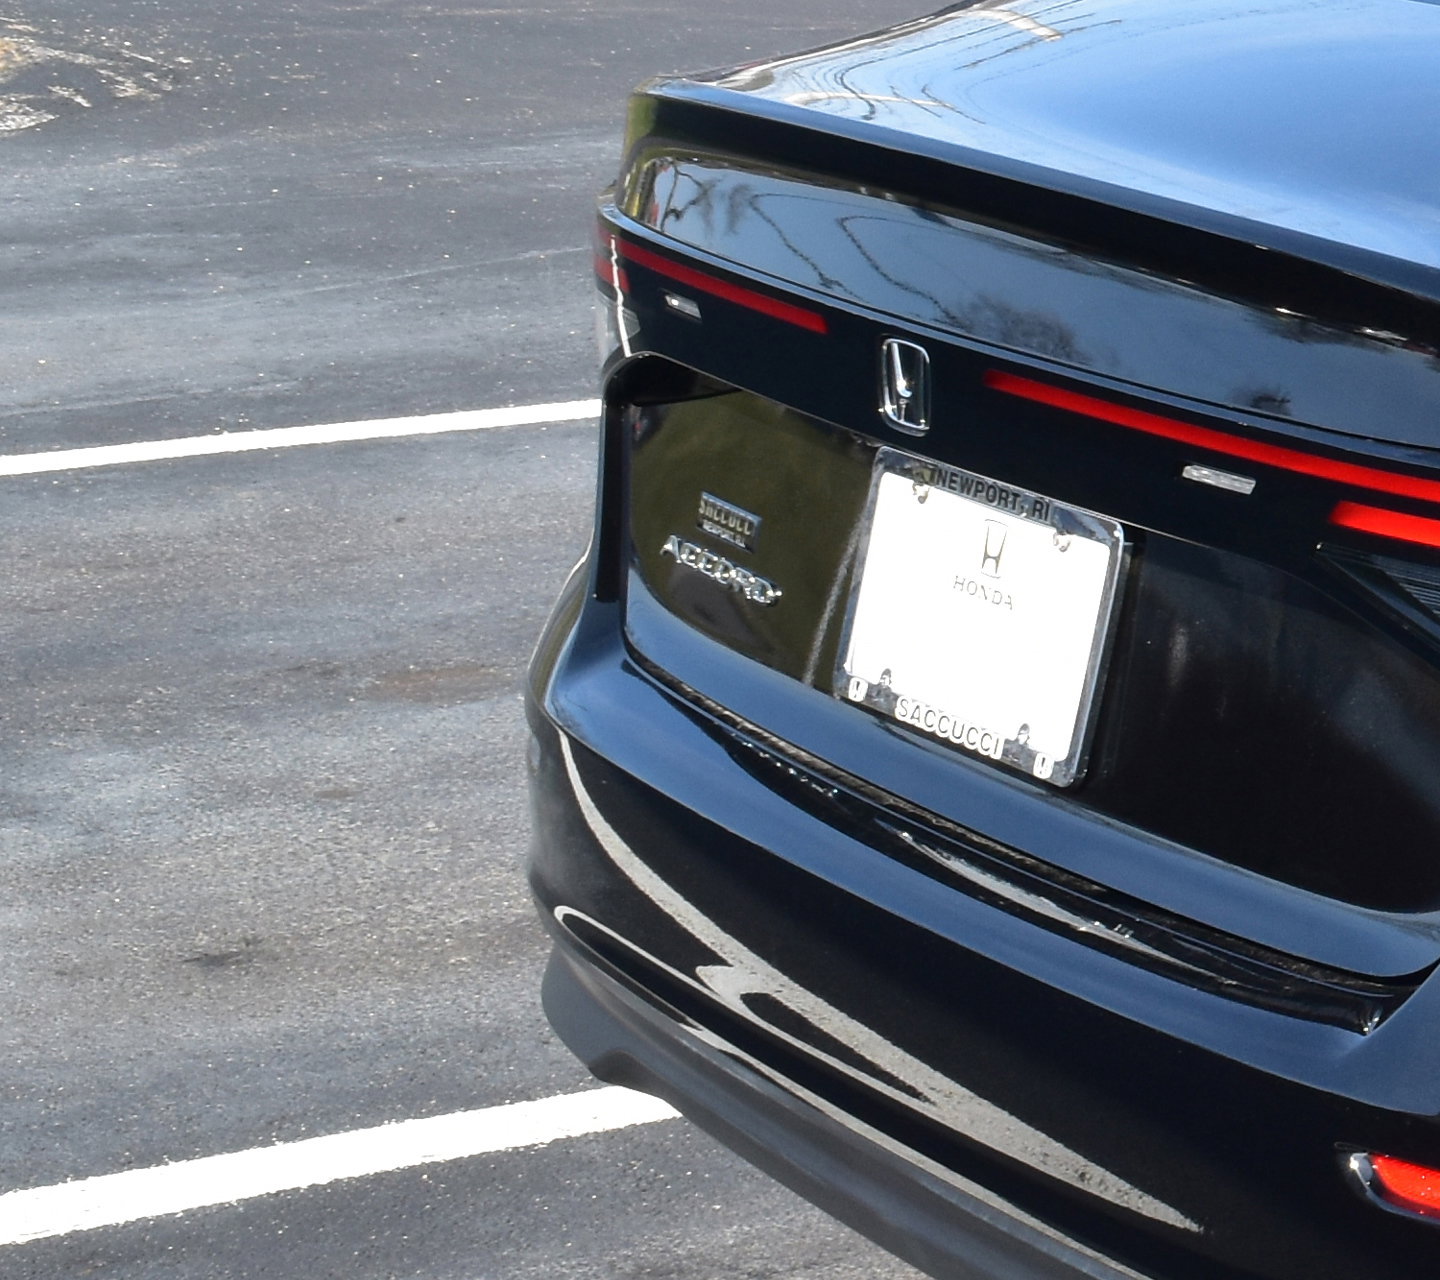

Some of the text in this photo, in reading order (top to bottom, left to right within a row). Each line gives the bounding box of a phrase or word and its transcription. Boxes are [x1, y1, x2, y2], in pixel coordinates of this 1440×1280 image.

[1031, 497, 1051, 522] RI
[659, 534, 781, 605] ACCORD
[952, 575, 1013, 610] HONDA
[898, 698, 1001, 757] SACCUCCI
